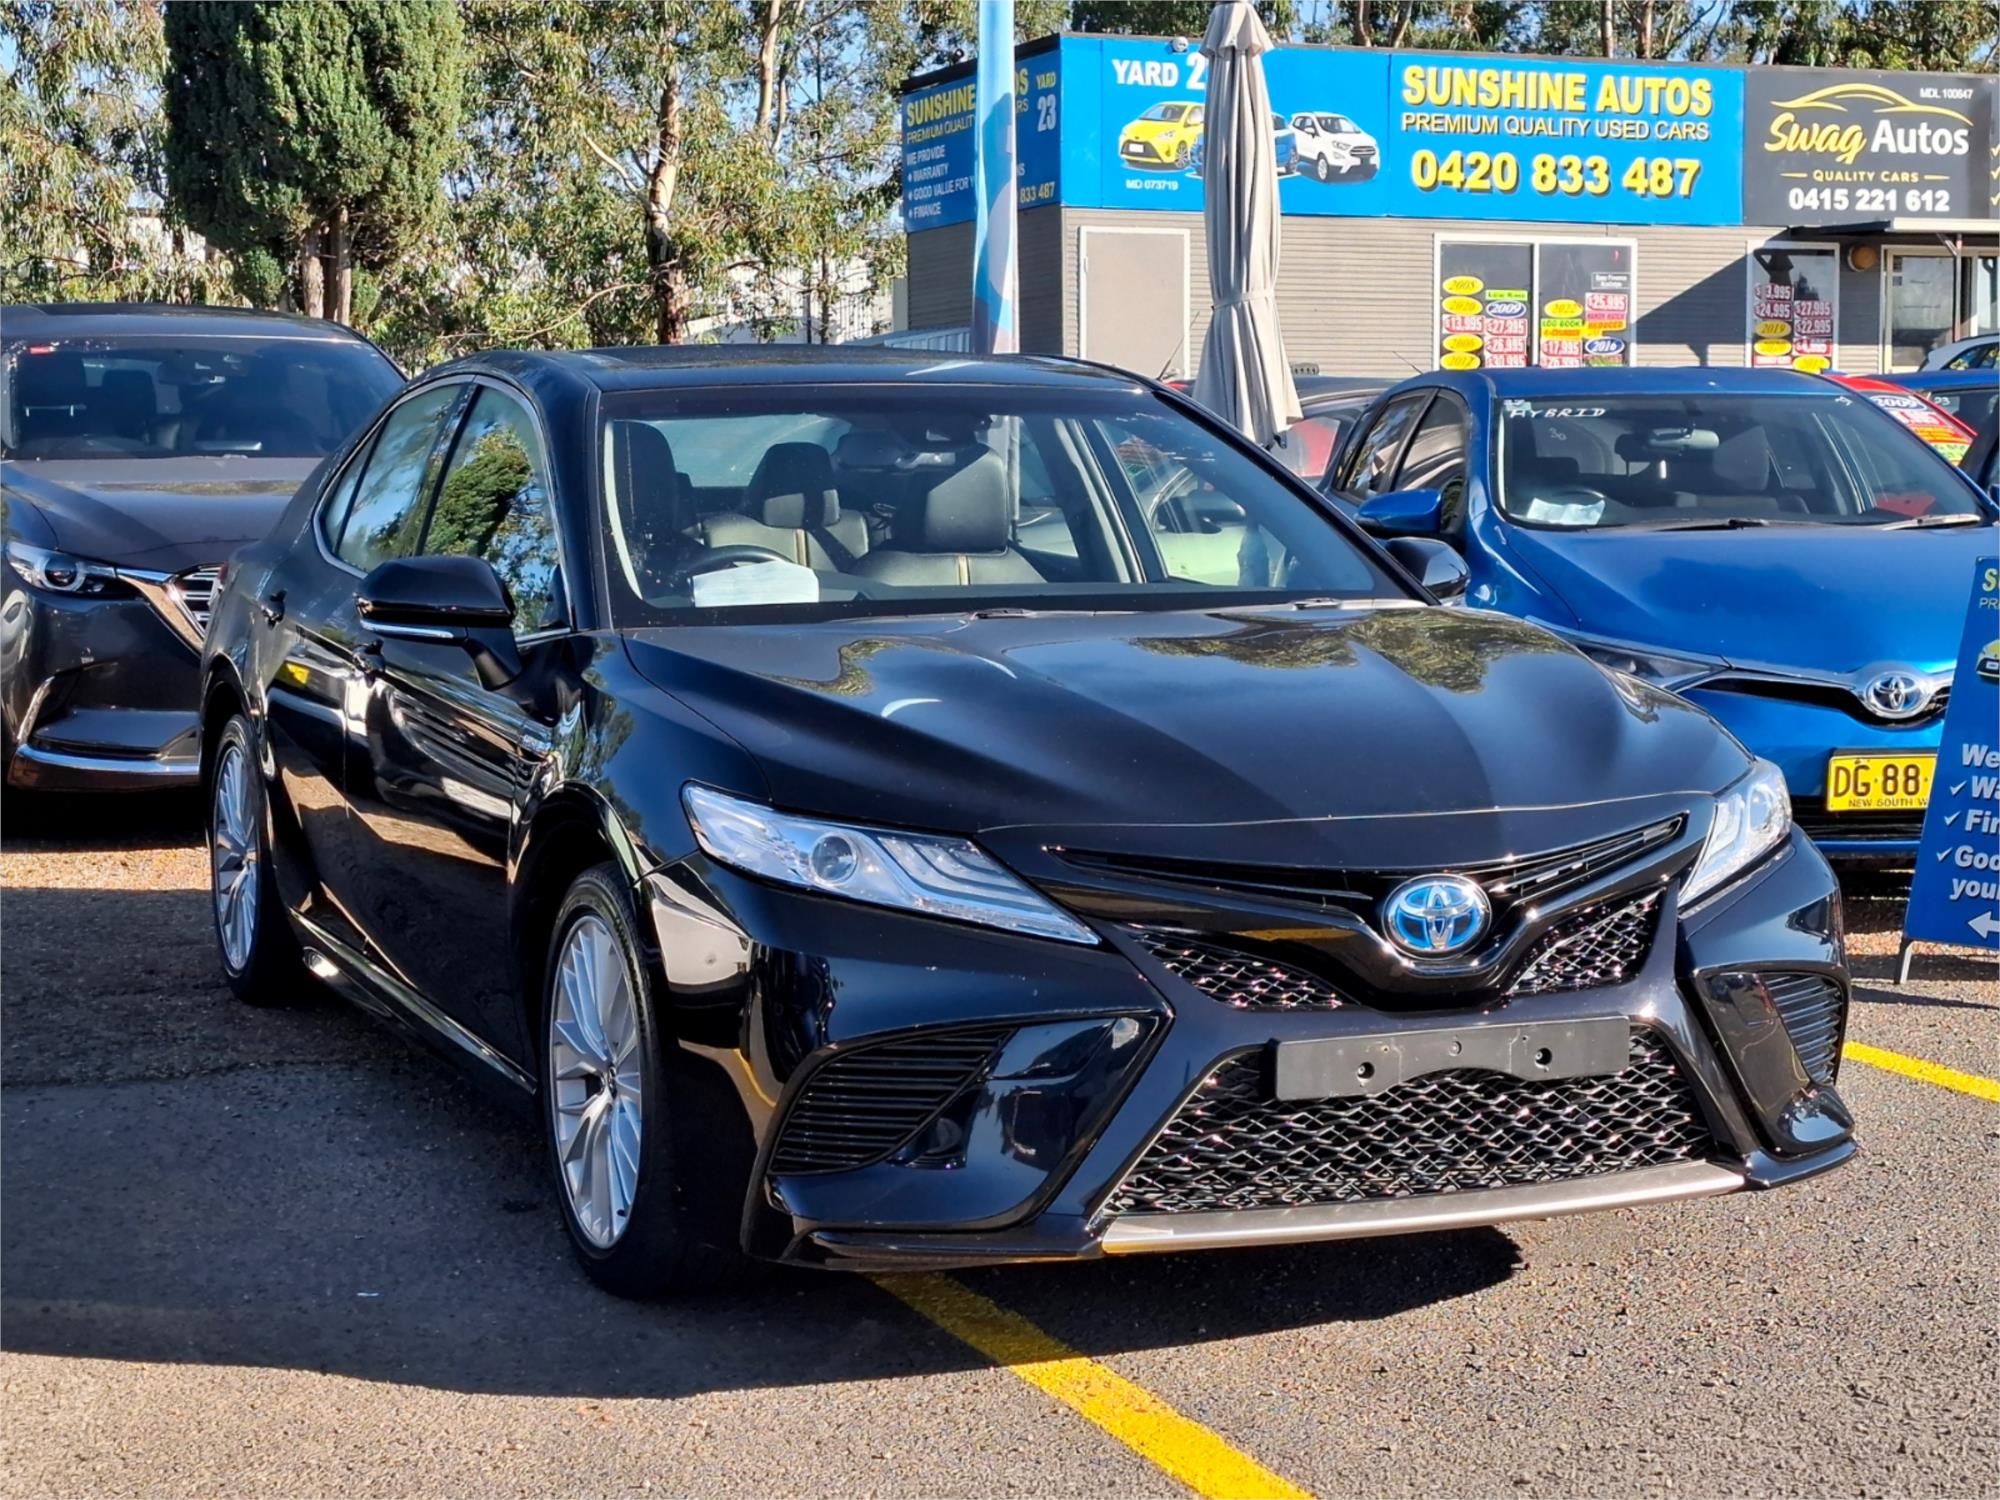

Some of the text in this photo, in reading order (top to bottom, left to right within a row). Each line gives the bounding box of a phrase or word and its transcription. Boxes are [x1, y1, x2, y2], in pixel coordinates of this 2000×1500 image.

[1036, 72, 1057, 90] YARD
[1112, 51, 1206, 90] YARD 2
[1402, 64, 1713, 117] SUNSHINE AUTOS
[1919, 88, 1941, 99] MDL
[907, 83, 976, 128] SUNSHINE
[1037, 94, 1057, 132] 23
[907, 124, 944, 145] PREMIUM
[1401, 112, 1711, 141] PREMIUM QUALITY USED CARS
[1764, 112, 1969, 165] Swag Autos
[906, 145, 945, 166] WE PROVIDE
[913, 163, 949, 183] WARRANTY
[1411, 148, 1701, 198] 0420 833 487
[1812, 169, 1919, 182] QUALITY CARS
[914, 184, 932, 201] GOOD
[933, 180, 955, 197] VALUE
[955, 177, 969, 192] FOR
[1019, 181, 1056, 204] 833 487
[1125, 179, 1142, 189] MD
[1788, 187, 1950, 212] 0415 221 612
[914, 202, 942, 219] FINANCE
[1491, 303, 1521, 315] 2009
[1591, 339, 1618, 352] 2016
[1510, 408, 1606, 418] HYBRID
[1848, 799, 1872, 807] NEW
[1876, 798, 1913, 807] SOUTH
